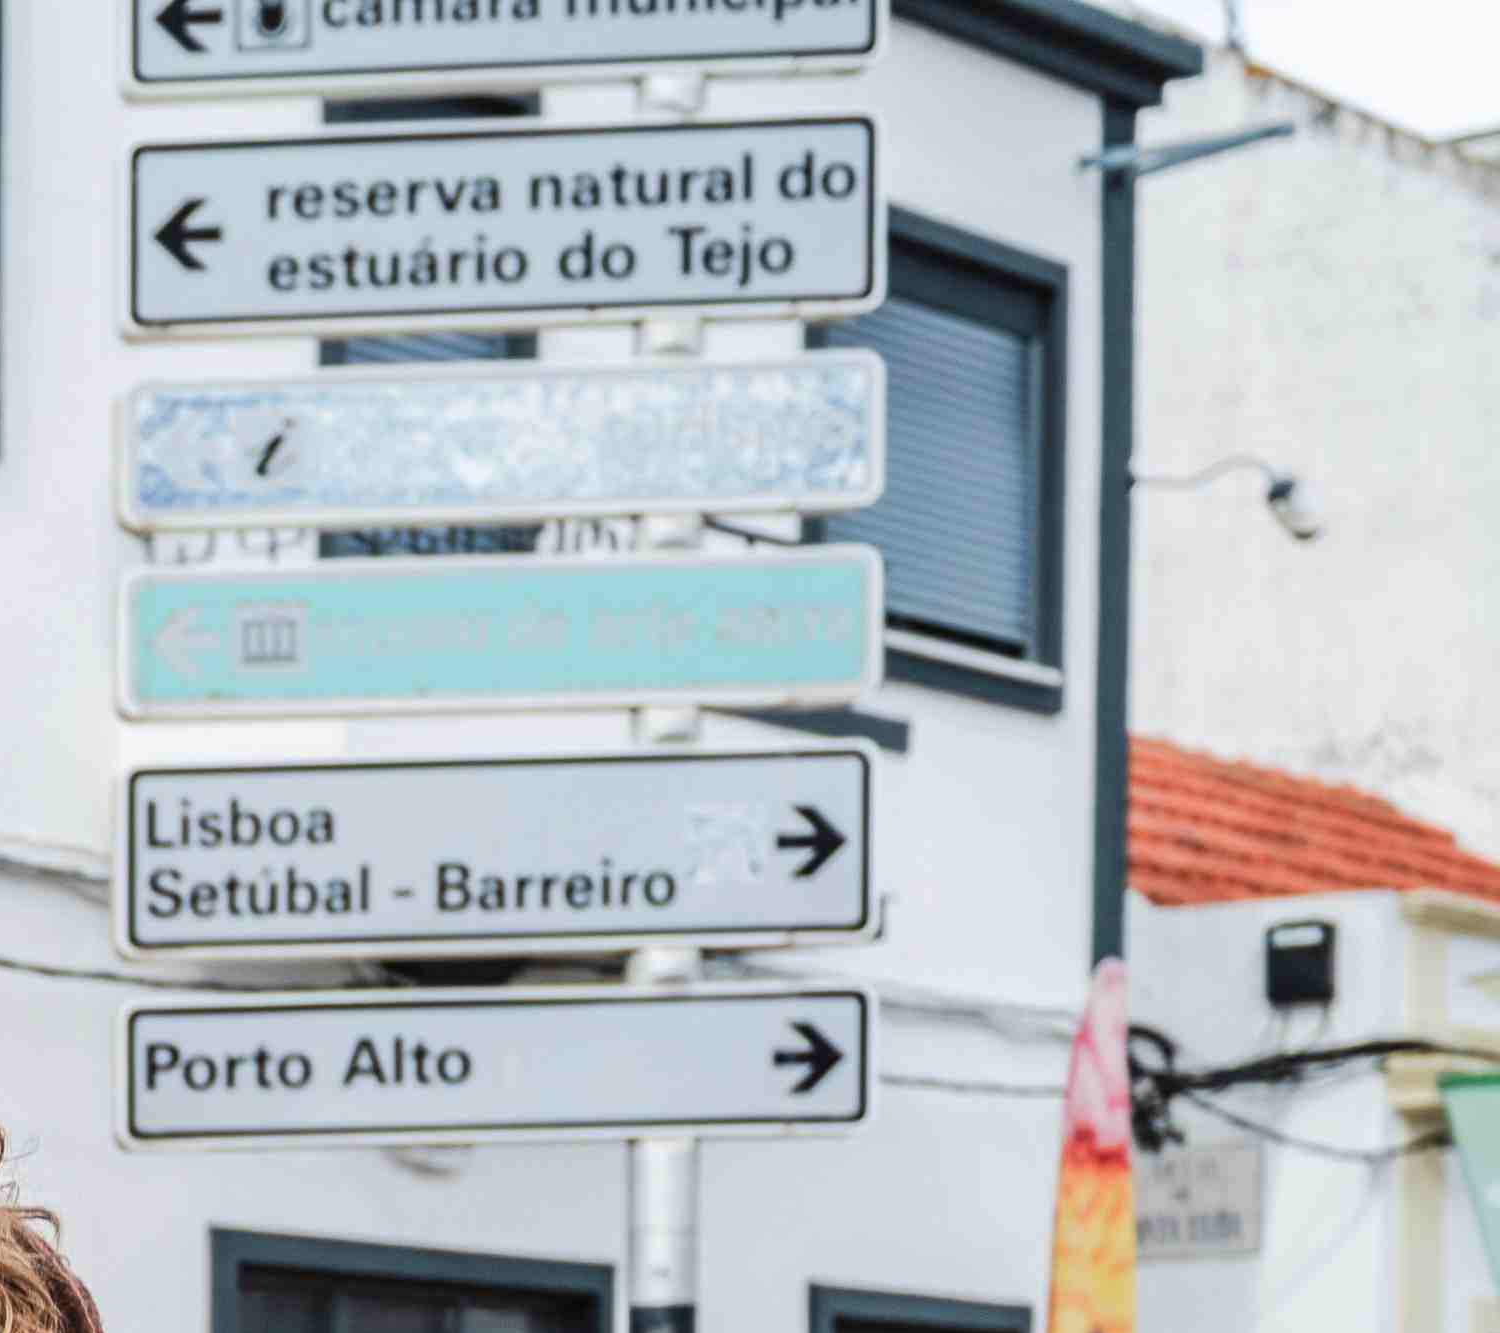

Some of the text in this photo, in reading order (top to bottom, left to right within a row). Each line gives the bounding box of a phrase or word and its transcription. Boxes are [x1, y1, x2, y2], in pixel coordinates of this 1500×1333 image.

[267, 151, 857, 219] reserva natural do
[267, 226, 796, 291] estuário do Tejo
[146, 799, 334, 848] Lisboa
[147, 863, 369, 919] Setúbal
[436, 859, 676, 912] Barreiro
[145, 1037, 472, 1091] Porto Alto
